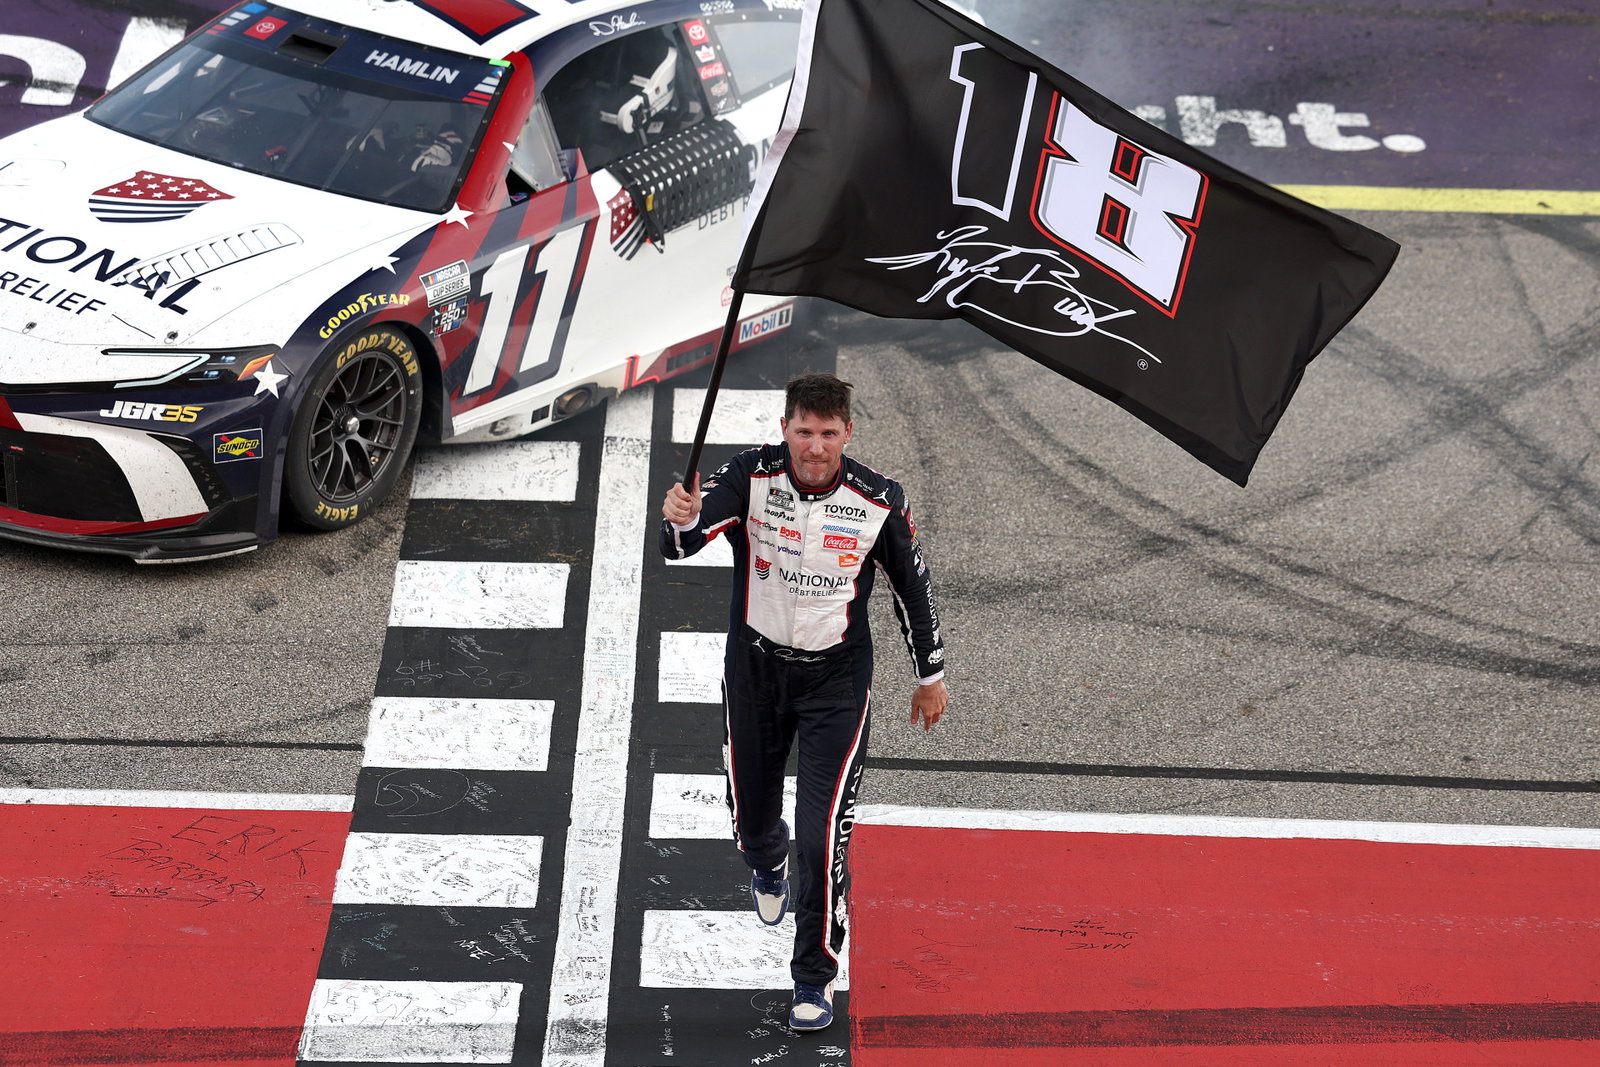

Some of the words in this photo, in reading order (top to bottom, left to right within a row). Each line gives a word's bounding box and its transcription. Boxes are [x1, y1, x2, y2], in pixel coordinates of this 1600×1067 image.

[364, 50, 460, 84] HAMLIN
[949, 42, 1210, 319] 18
[435, 265, 462, 283] NASCAR
[0, 271, 107, 315] RELIEF
[432, 286, 446, 299] CUP
[445, 279, 465, 296] SERIES
[318, 292, 410, 339] GOODYEAR
[439, 308, 460, 326] 250
[462, 222, 586, 396] 11
[740, 312, 777, 341] Mobil
[778, 307, 791, 326] 1
[336, 332, 419, 377] GOODYEAR
[217, 439, 260, 453] SUNOCO
[314, 501, 359, 521] EAGLE
[823, 504, 867, 519] TOYOTA
[825, 514, 867, 523] RACING
[821, 524, 862, 536] PROGRESSIVE
[789, 587, 810, 597] DEBT
[811, 589, 837, 597] RELIEF
